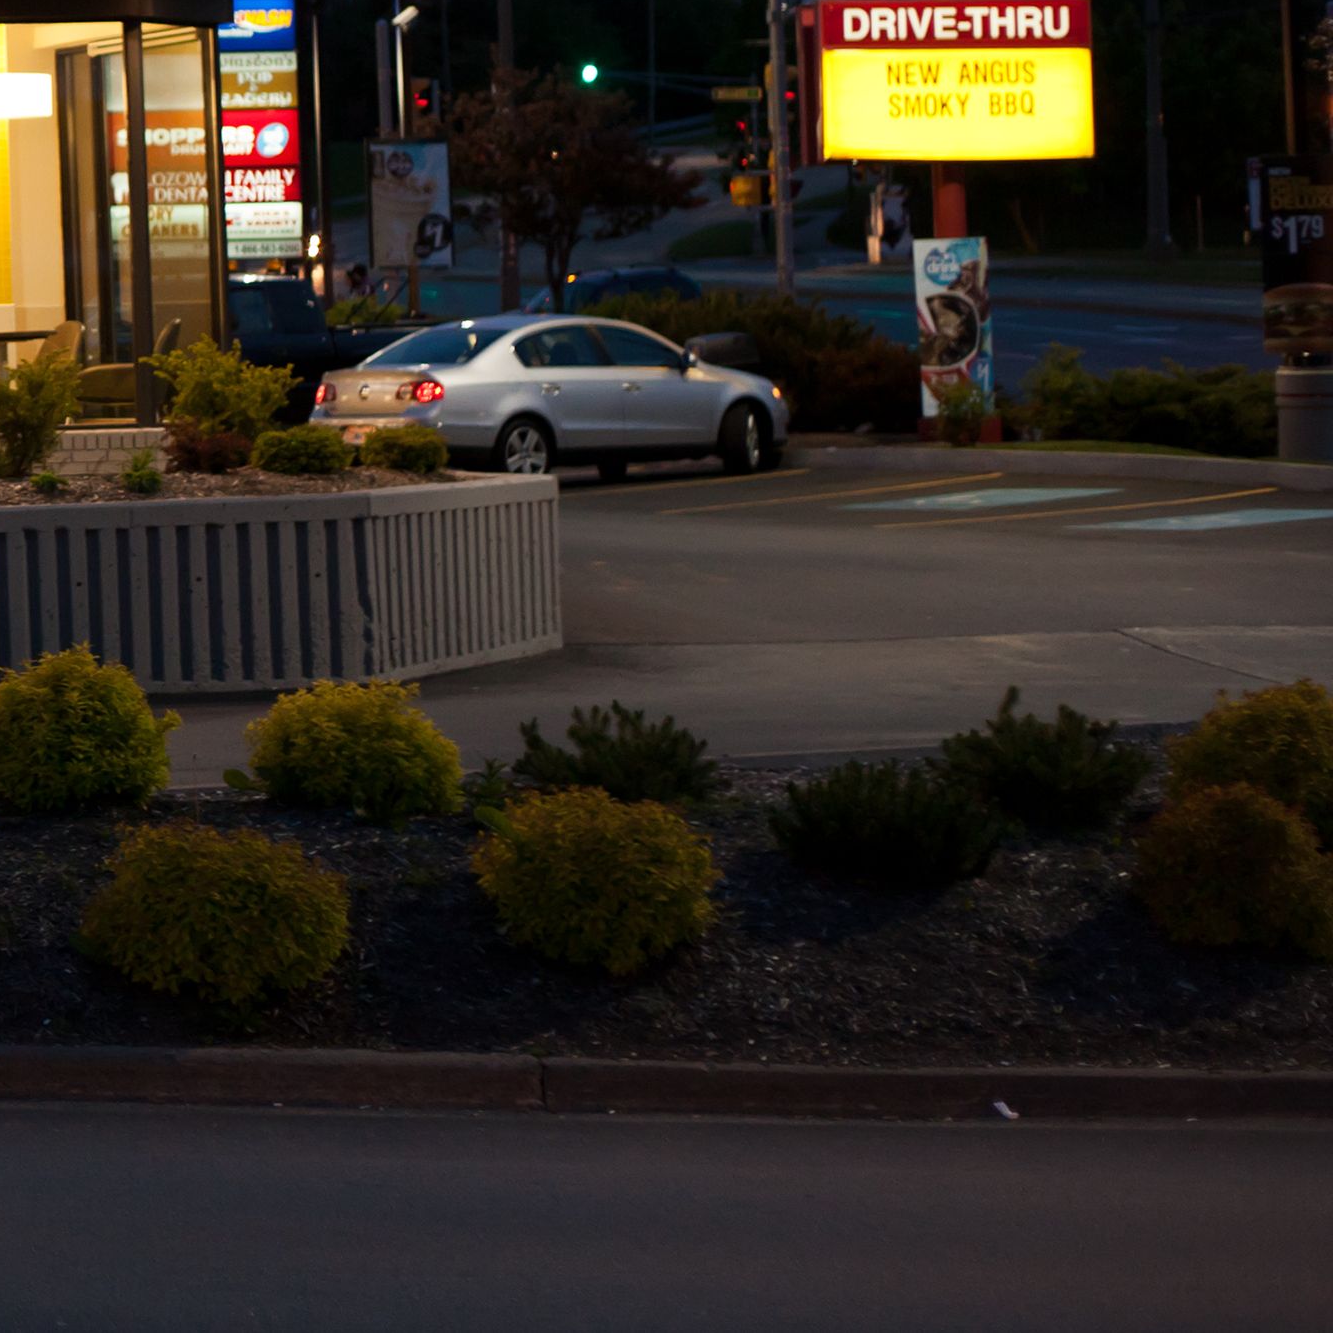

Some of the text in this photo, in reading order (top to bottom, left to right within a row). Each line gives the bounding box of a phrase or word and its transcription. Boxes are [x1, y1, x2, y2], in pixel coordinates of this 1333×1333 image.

[842, 5, 1071, 42] DRIVE-THRU
[887, 60, 1035, 85] NEW ANGUS
[889, 91, 1035, 118] SMOKY BBQ
[233, 169, 295, 185] FAMILY
